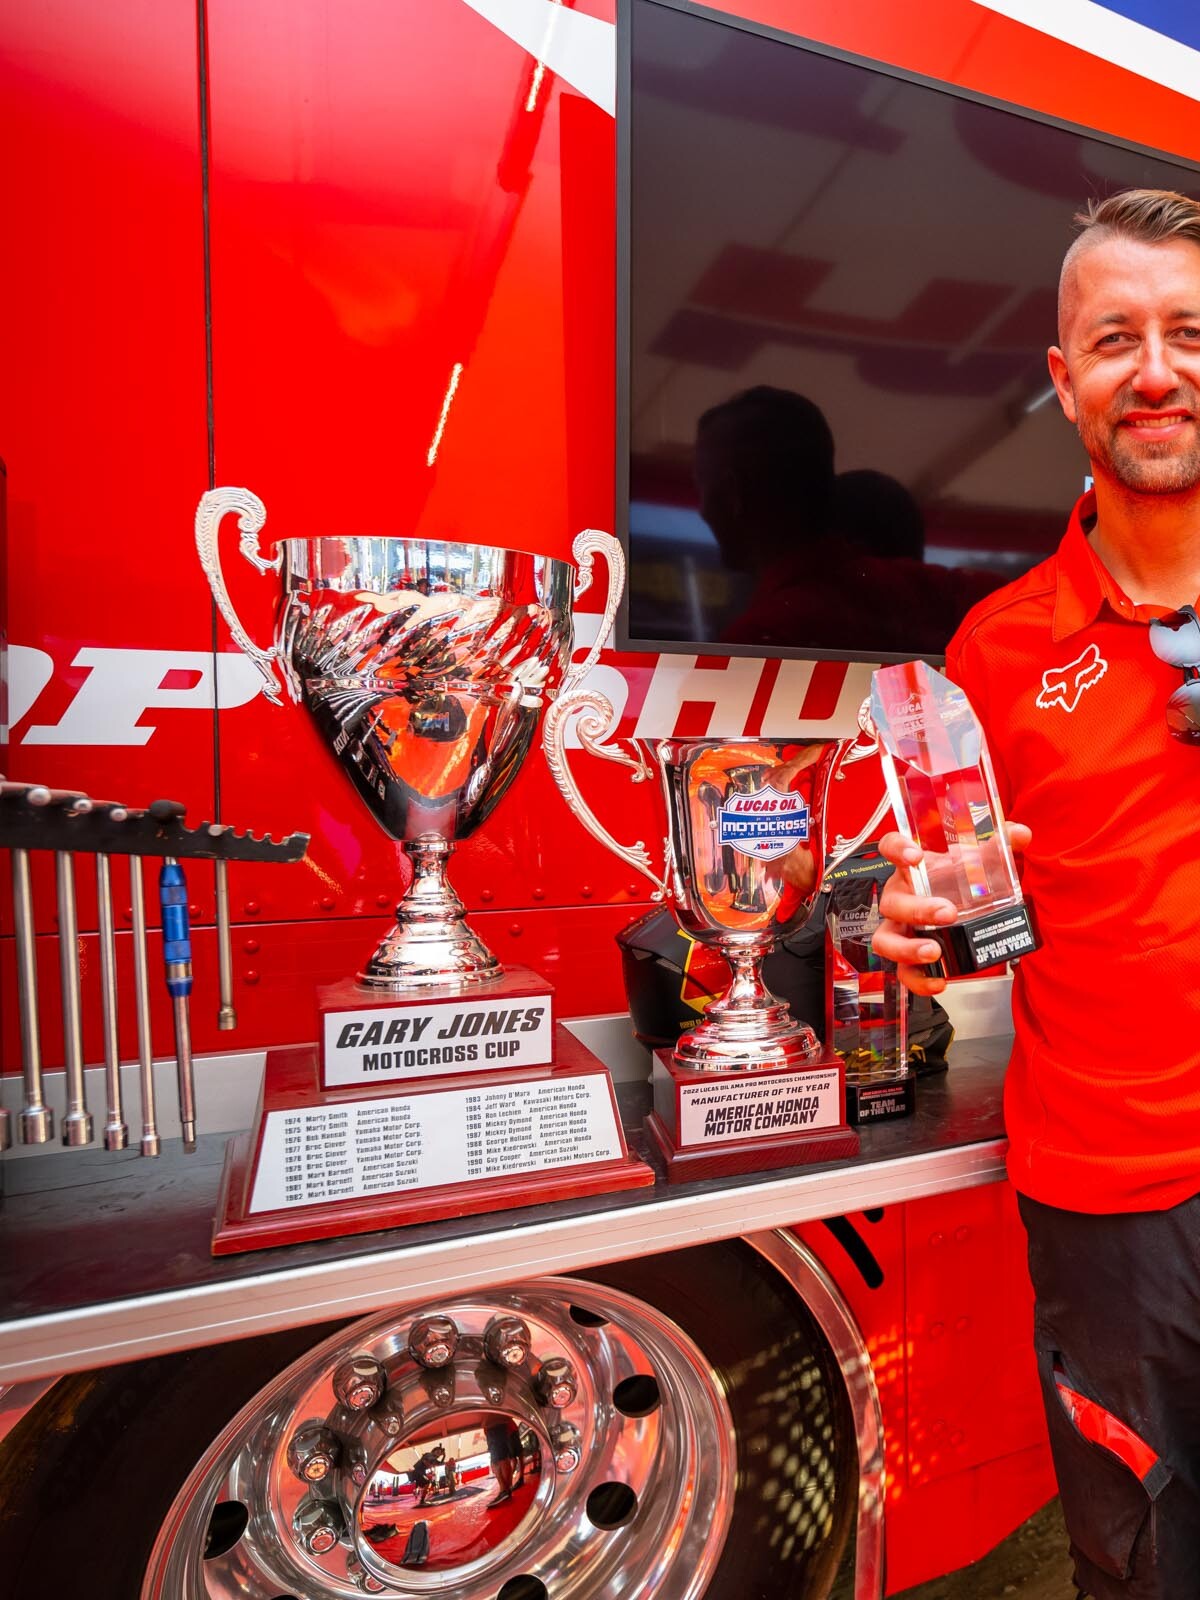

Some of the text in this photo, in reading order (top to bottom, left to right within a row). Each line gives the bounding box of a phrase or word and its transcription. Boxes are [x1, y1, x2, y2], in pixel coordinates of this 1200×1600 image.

[735, 799, 796, 811] LUCAS OIL
[723, 819, 805, 831] MOTOCROSS
[976, 931, 1029, 955] TEAM MANAGER
[976, 937, 1032, 963] OF THE YEAR
[337, 1008, 544, 1048] GARY JONES
[363, 1040, 520, 1071] MOTOCROSS CUP
[758, 1077, 793, 1086] MOTOCROSS
[794, 1072, 837, 1082] CHAMPIONSHIP
[523, 1097, 551, 1105] Kawasaki
[553, 1094, 574, 1102] Motors
[576, 1092, 591, 1100] Corp.
[538, 1086, 565, 1095] American
[691, 1090, 769, 1106] MANUFACTURER
[785, 1086, 803, 1094] THE
[806, 1083, 830, 1092] YEAR
[499, 1109, 521, 1117] Lechien
[529, 1105, 557, 1113] American
[705, 1097, 819, 1123] AMERICAN HONDA
[871, 1099, 895, 1109] TEAM
[886, 1104, 905, 1112] YEAR
[306, 1115, 326, 1123] Marty
[329, 1112, 348, 1120] Smith
[357, 1107, 388, 1117] American
[391, 1105, 410, 1113] Honda
[486, 1120, 506, 1128] Mickey
[509, 1117, 532, 1125] Dymond
[540, 1112, 568, 1121] American
[306, 1124, 326, 1132] Marty
[357, 1117, 388, 1126] American
[355, 1128, 381, 1136] Yamaha
[383, 1124, 402, 1132] Motor
[485, 1129, 506, 1137] Mickey
[509, 1126, 531, 1134] Dymond
[539, 1121, 567, 1130] American
[569, 1118, 586, 1126] Honda
[704, 1110, 817, 1136] MOTOR COMPANY
[383, 1133, 403, 1141] Motor
[486, 1137, 508, 1146] George
[540, 1129, 568, 1138] American
[503, 1143, 536, 1152] Kiedrowski
[545, 1137, 572, 1146] American
[326, 1150, 347, 1158] Glover
[384, 1142, 403, 1150] Motor
[487, 1156, 498, 1164] Guy
[500, 1154, 521, 1162] Cooper
[529, 1148, 557, 1157] American
[560, 1145, 578, 1153] Suzuki
[286, 1165, 301, 1173] 1979
[326, 1159, 347, 1167] Glover
[357, 1155, 382, 1163] Yamaha
[385, 1151, 404, 1159] Motor
[308, 1171, 325, 1179] Mark
[328, 1168, 353, 1177] Barnett
[363, 1162, 394, 1171] American
[397, 1159, 418, 1167] Suzuki
[502, 1160, 536, 1170] Kiedrowski
[544, 1155, 572, 1164] Kawasaki
[574, 1152, 594, 1160] Motors
[286, 1184, 301, 1192] 1981
[307, 1181, 323, 1189] Mark
[327, 1177, 352, 1186] Barnett
[362, 1172, 393, 1181] American
[328, 1187, 354, 1195] Barnett
[363, 1181, 395, 1190] American
[397, 1178, 418, 1186] Suzuki
